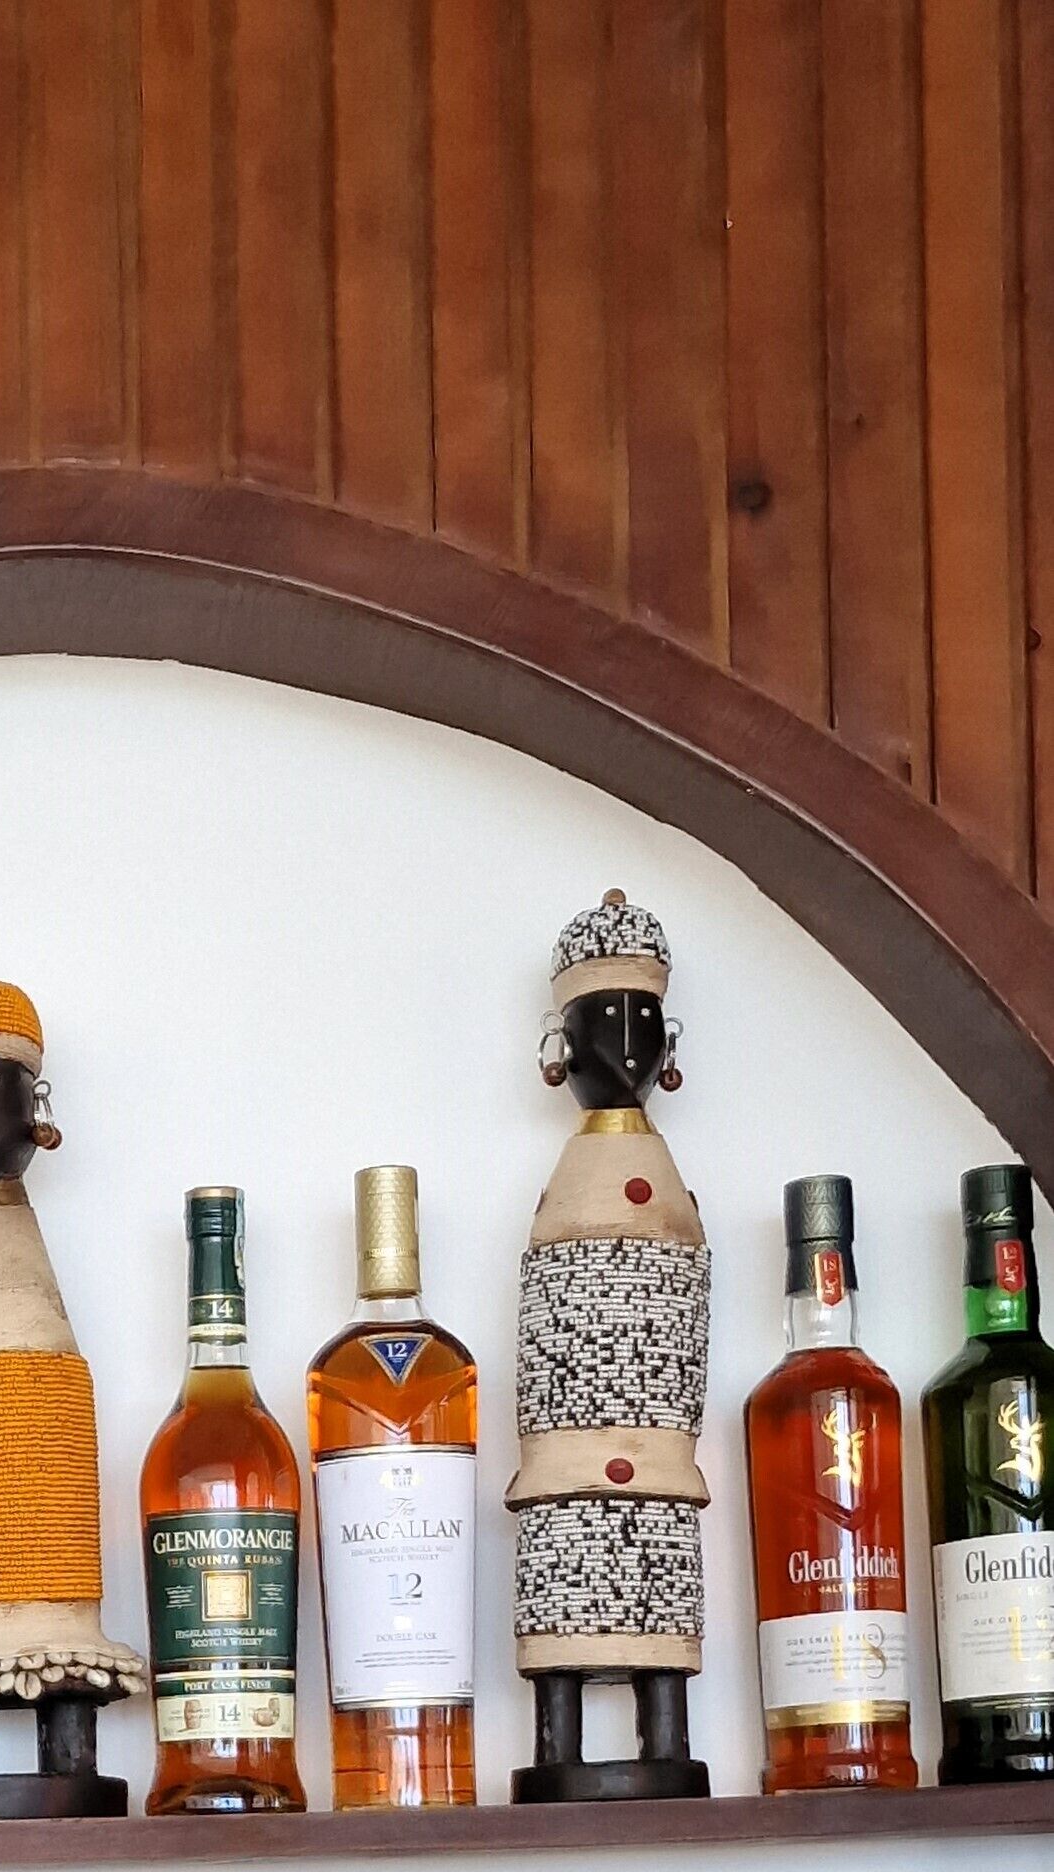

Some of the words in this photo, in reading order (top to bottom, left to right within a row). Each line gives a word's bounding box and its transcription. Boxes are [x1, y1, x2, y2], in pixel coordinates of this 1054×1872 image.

[208, 1299, 233, 1318] 14
[386, 1341, 407, 1358] 12
[153, 1528, 295, 1555] GLENMORANGIE
[340, 1519, 463, 1544] MACALLAN
[187, 1554, 238, 1567] QUINTA
[965, 1545, 1054, 1585] Glenfid
[387, 1572, 423, 1600] 12
[184, 1681, 209, 1693] PORT
[211, 1680, 239, 1691] CASK
[240, 1679, 273, 1691] FINISH
[218, 1703, 241, 1723] 14
